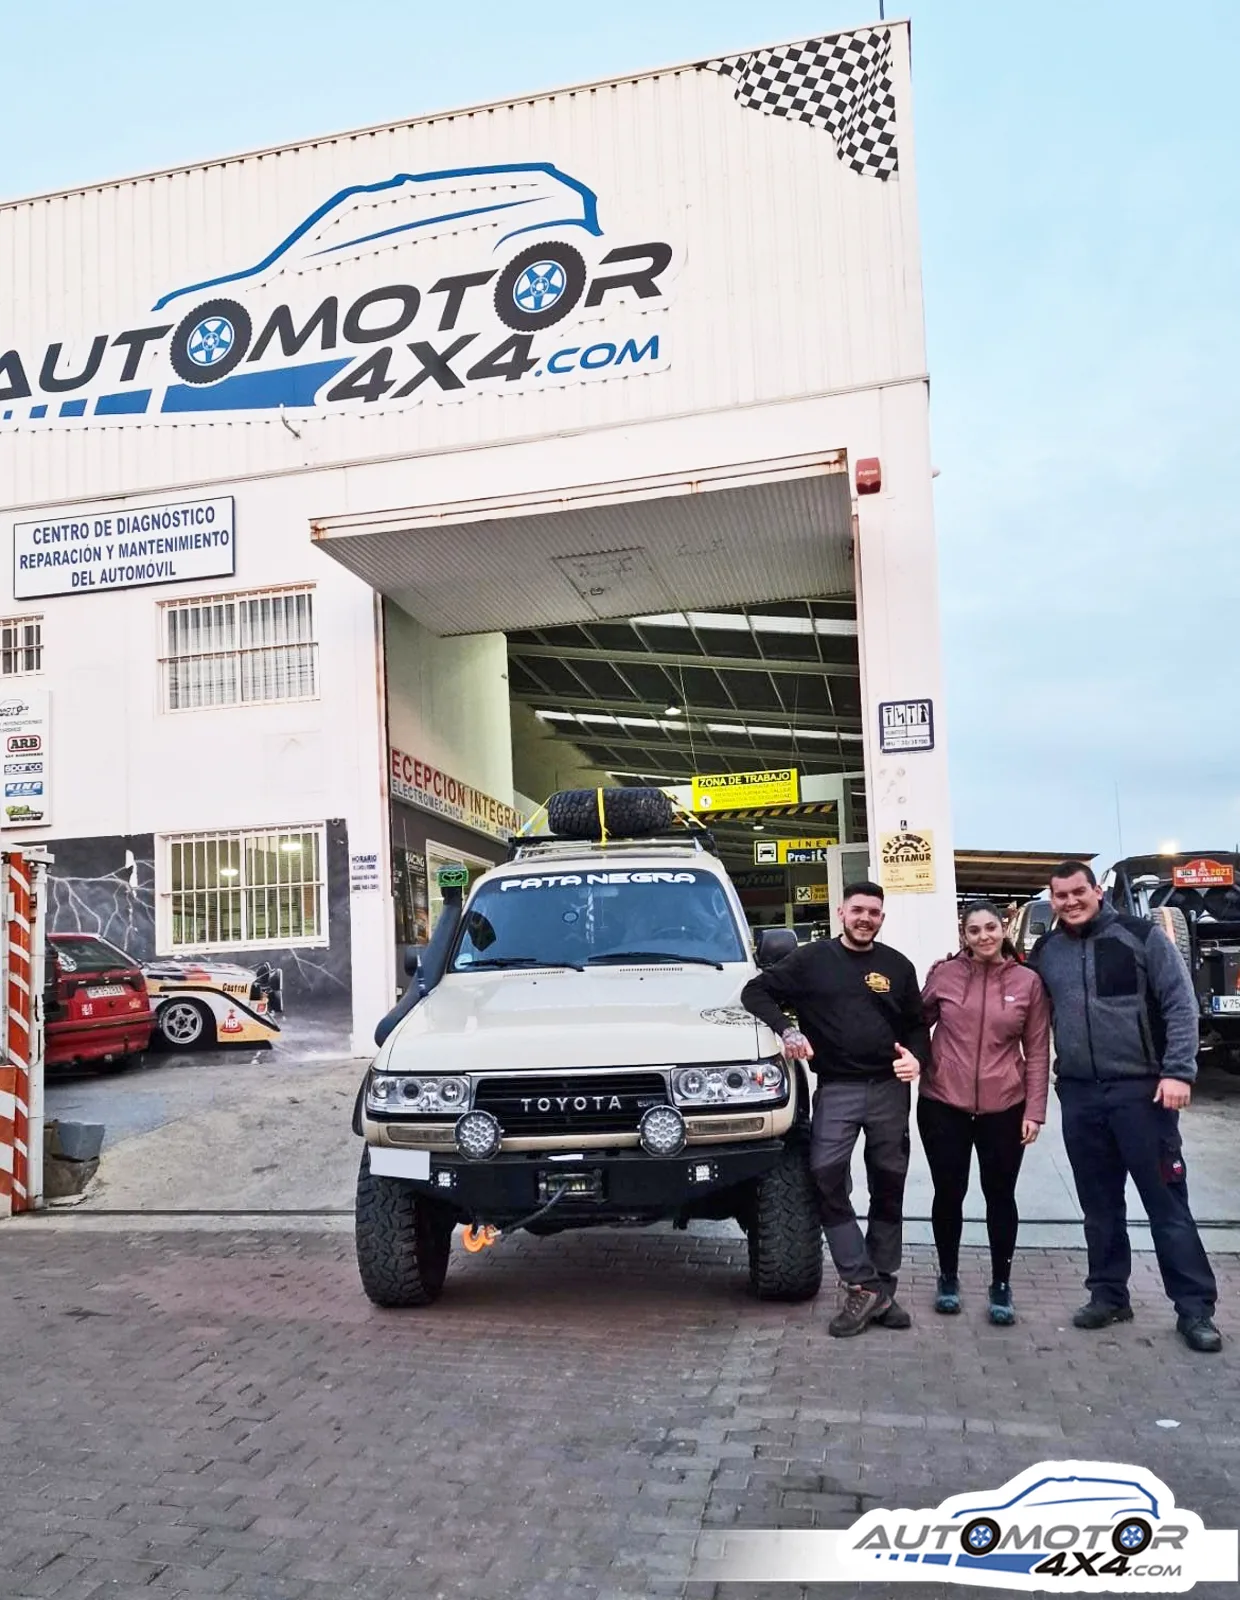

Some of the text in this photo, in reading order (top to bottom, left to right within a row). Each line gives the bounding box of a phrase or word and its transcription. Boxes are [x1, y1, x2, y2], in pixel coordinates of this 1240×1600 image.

[33, 506, 215, 545] CENTRO DE DIAGNÓSTICO
[20, 530, 229, 569] REPARACIÓN Y MANTENIMIENTO
[71, 559, 176, 587] DEL AUTOMÓVIL
[11, 738, 38, 749] ARB
[700, 772, 790, 787] ZONA DE TRABAJO
[788, 840, 831, 848] LINEA
[883, 853, 931, 863] GRETAMUR
[500, 872, 696, 892] PATA NEGRA
[521, 1096, 621, 1113] TOYOTA
